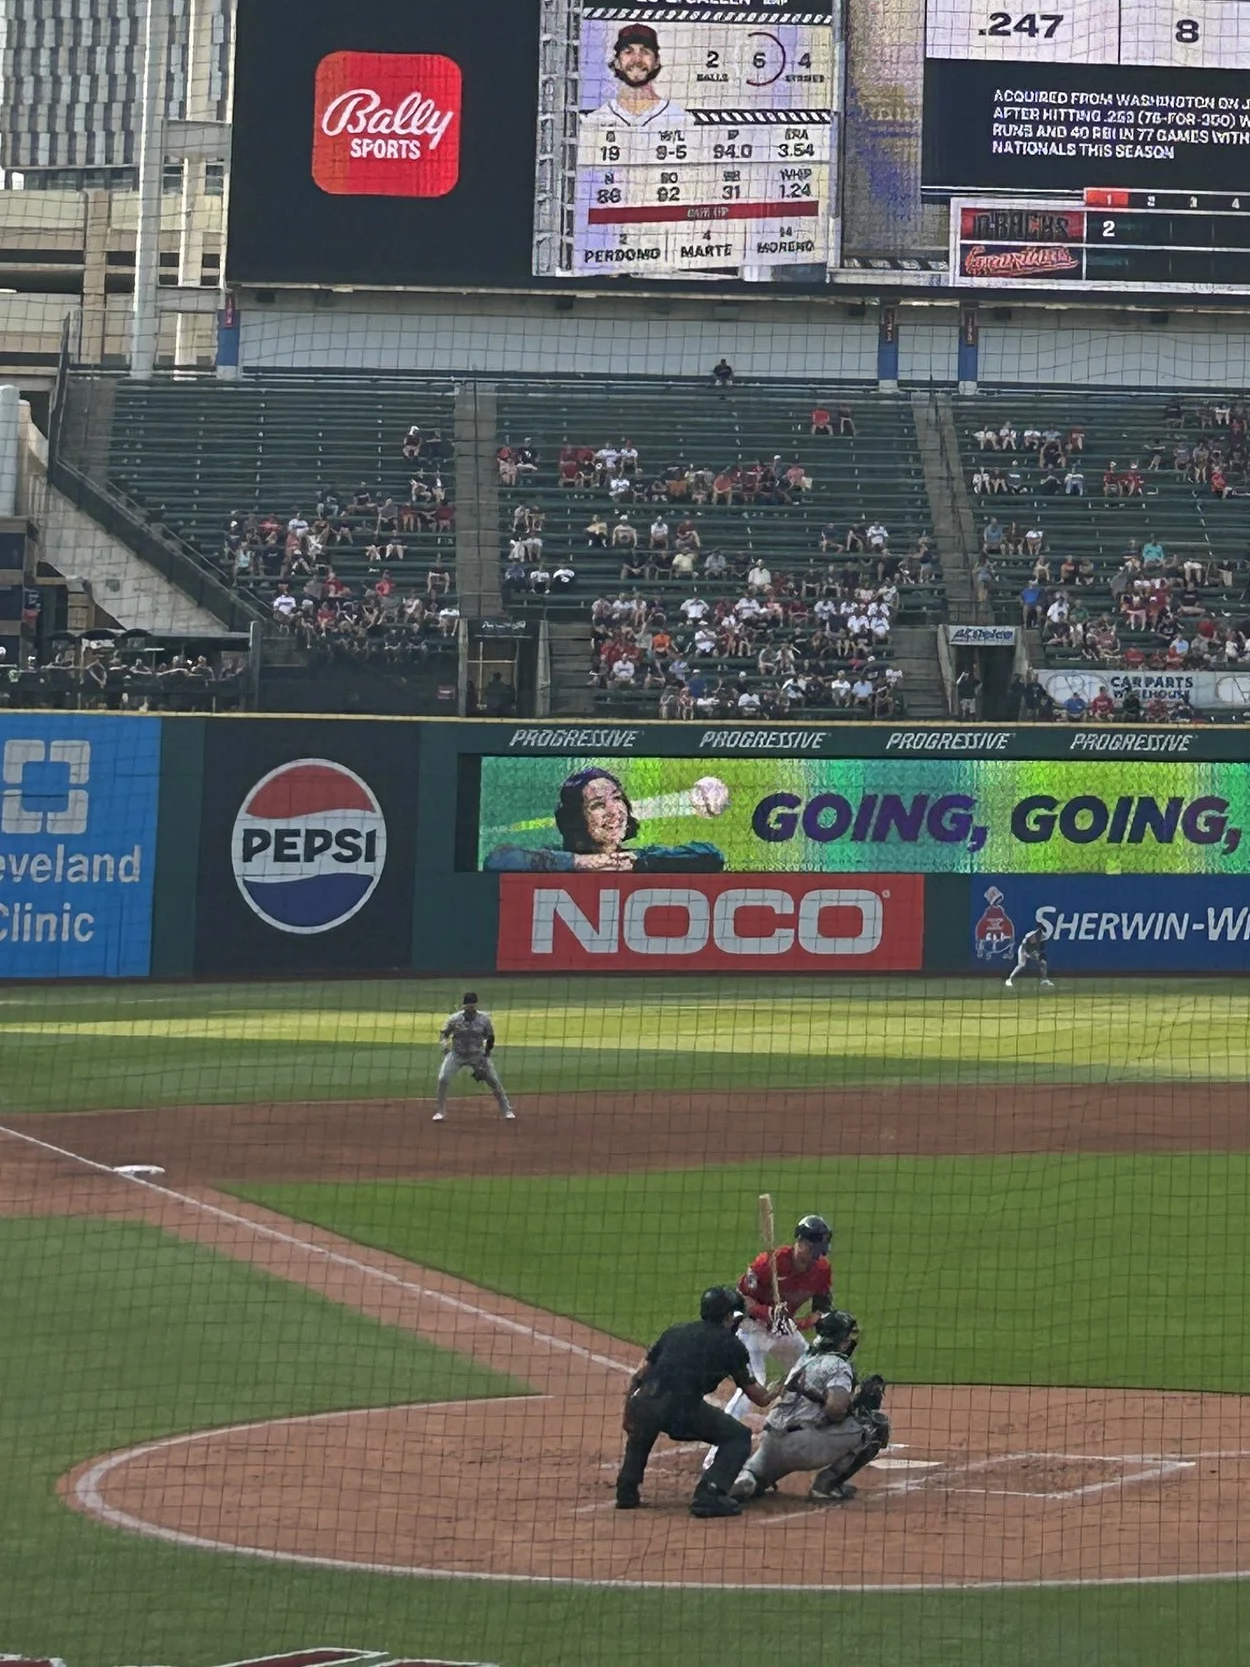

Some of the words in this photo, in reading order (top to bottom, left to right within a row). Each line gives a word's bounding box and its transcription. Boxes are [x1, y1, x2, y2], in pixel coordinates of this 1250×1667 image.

[978, 12, 1065, 40] .247
[1174, 19, 1200, 45] 8
[706, 51, 719, 68] 2
[752, 52, 766, 69] 6
[798, 52, 812, 68] 4
[993, 89, 1068, 105] ACQUIRED
[1071, 92, 1113, 106] FROM
[1115, 94, 1214, 110] WASHINGTON
[1219, 97, 1239, 110] ON
[321, 87, 455, 151] Bally
[993, 107, 1040, 121] AFTER
[1043, 109, 1101, 123] HITTING
[1036, 125, 1067, 139] AND
[1070, 127, 1090, 140] 40
[1119, 128, 1134, 141] IN
[1157, 130, 1209, 145] GAMES
[1212, 130, 1250, 145] WITH
[349, 138, 422, 160] SPORTS
[992, 141, 1076, 157] NATIONALS
[1079, 143, 1113, 157] THIS
[1115, 144, 1175, 160] SEASON
[1105, 194, 1113, 206] 1
[1231, 198, 1241, 210] 4
[1102, 220, 1117, 238] 2
[680, 243, 733, 259] MARTE
[1148, 676, 1194, 689] PARTS
[510, 729, 638, 748] PROGRESSIVE
[700, 730, 826, 750] PROGRESSIVE
[886, 732, 1009, 751] PROGRESSIVE
[1069, 733, 1192, 752] PROGRESSIVE
[752, 792, 988, 853] GOING,
[1011, 794, 1242, 855] GOING,
[242, 827, 378, 864] PEPSI
[0, 843, 141, 884] veland
[531, 888, 884, 955] NOCO
